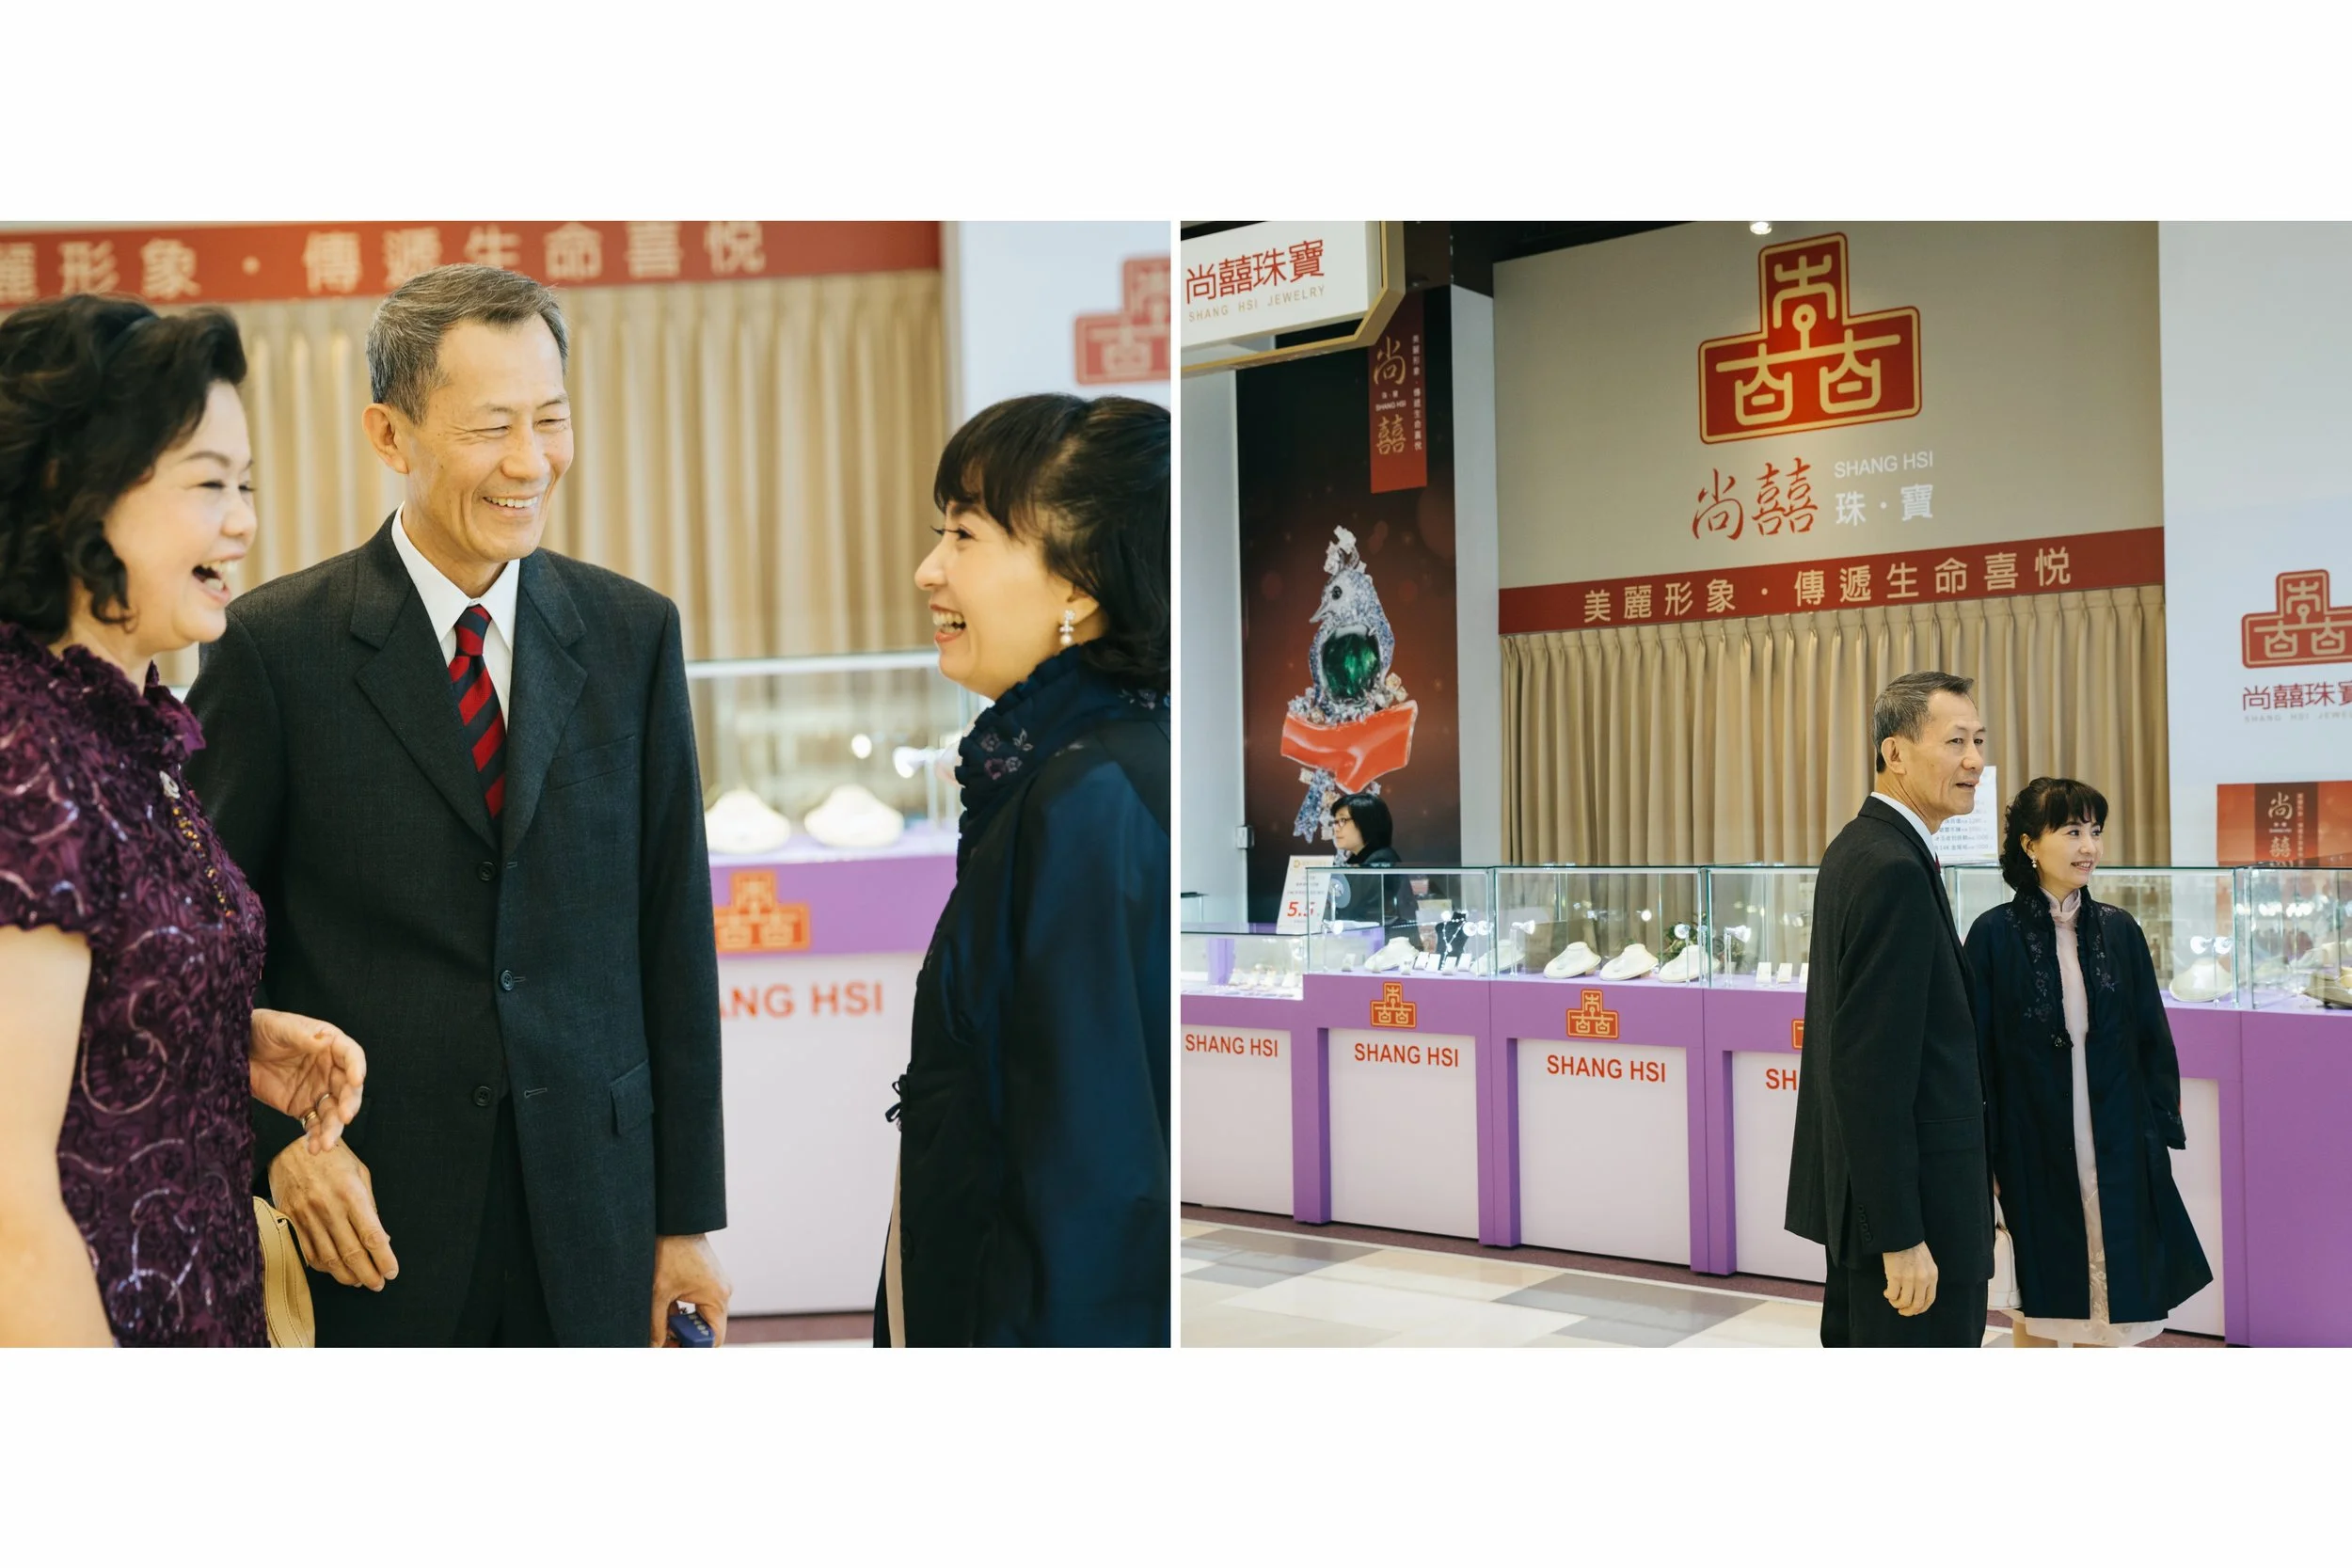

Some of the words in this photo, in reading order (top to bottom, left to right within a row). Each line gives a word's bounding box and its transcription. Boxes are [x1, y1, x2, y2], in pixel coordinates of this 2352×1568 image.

[1188, 305, 1229, 323] SHANG
[1238, 298, 1259, 312] HSI
[1267, 284, 1326, 307] JEWELRY
[1835, 454, 1899, 479] SHANG
[1903, 451, 1933, 470] HSI
[2244, 714, 2281, 723] SHANG
[810, 978, 883, 1019] HSI
[1185, 1034, 1245, 1054] SHANG
[1250, 1038, 1278, 1057] HSI
[1355, 1042, 1421, 1064] SHANG
[1427, 1047, 1458, 1067] HSI
[1547, 1054, 1623, 1079] SHANG
[1630, 1060, 1665, 1083] HSI
[1766, 1068, 1797, 1091] SH
